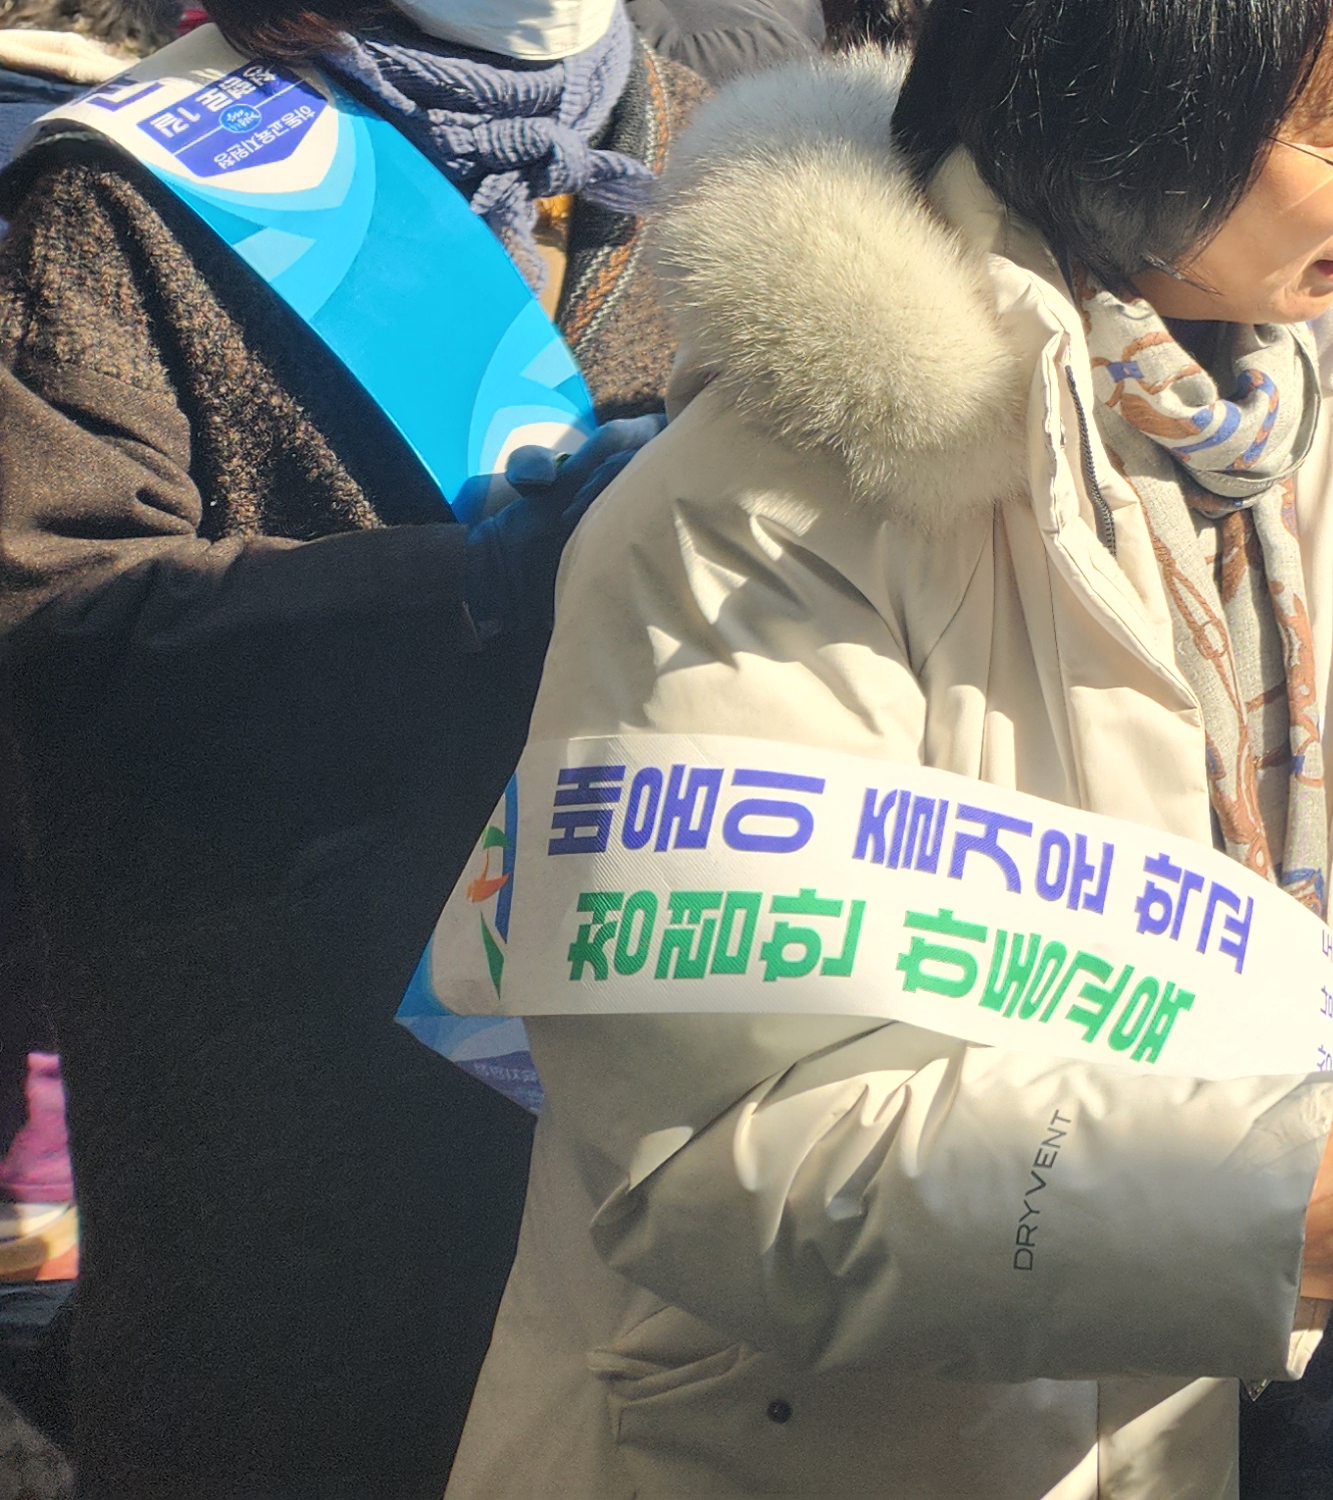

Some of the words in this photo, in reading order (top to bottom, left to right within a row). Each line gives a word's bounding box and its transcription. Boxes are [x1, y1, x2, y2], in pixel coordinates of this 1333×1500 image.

[213, 104, 318, 171] 하동교육지원청
[548, 763, 826, 856] 배움이
[853, 786, 1115, 912] 즐거운
[1134, 851, 1256, 975] 학교
[568, 887, 867, 983] 청렴한
[898, 907, 1195, 1064] 하동교육
[1014, 1108, 1073, 1272] DRYVENT
